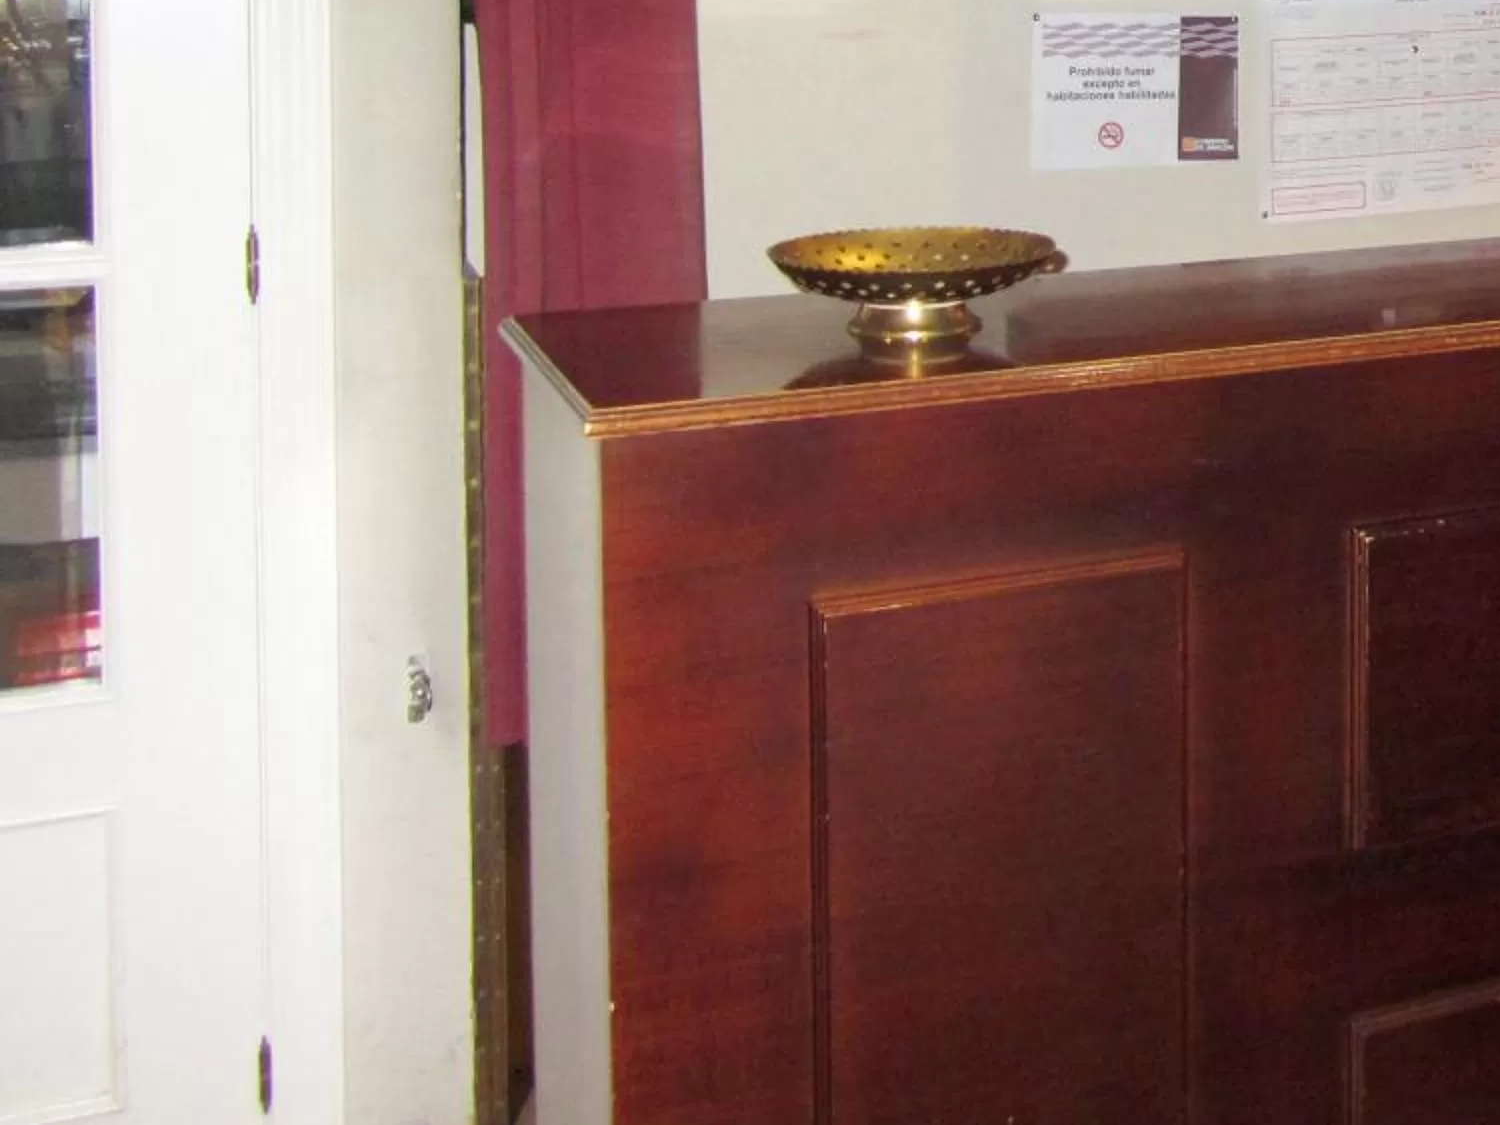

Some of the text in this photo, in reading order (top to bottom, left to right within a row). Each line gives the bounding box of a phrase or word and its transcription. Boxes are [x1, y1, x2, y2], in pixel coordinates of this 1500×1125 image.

[1068, 65, 1156, 76] Prohibido fumar
[1081, 79, 1141, 90] excepto en
[1045, 90, 1115, 102] habitaciones
